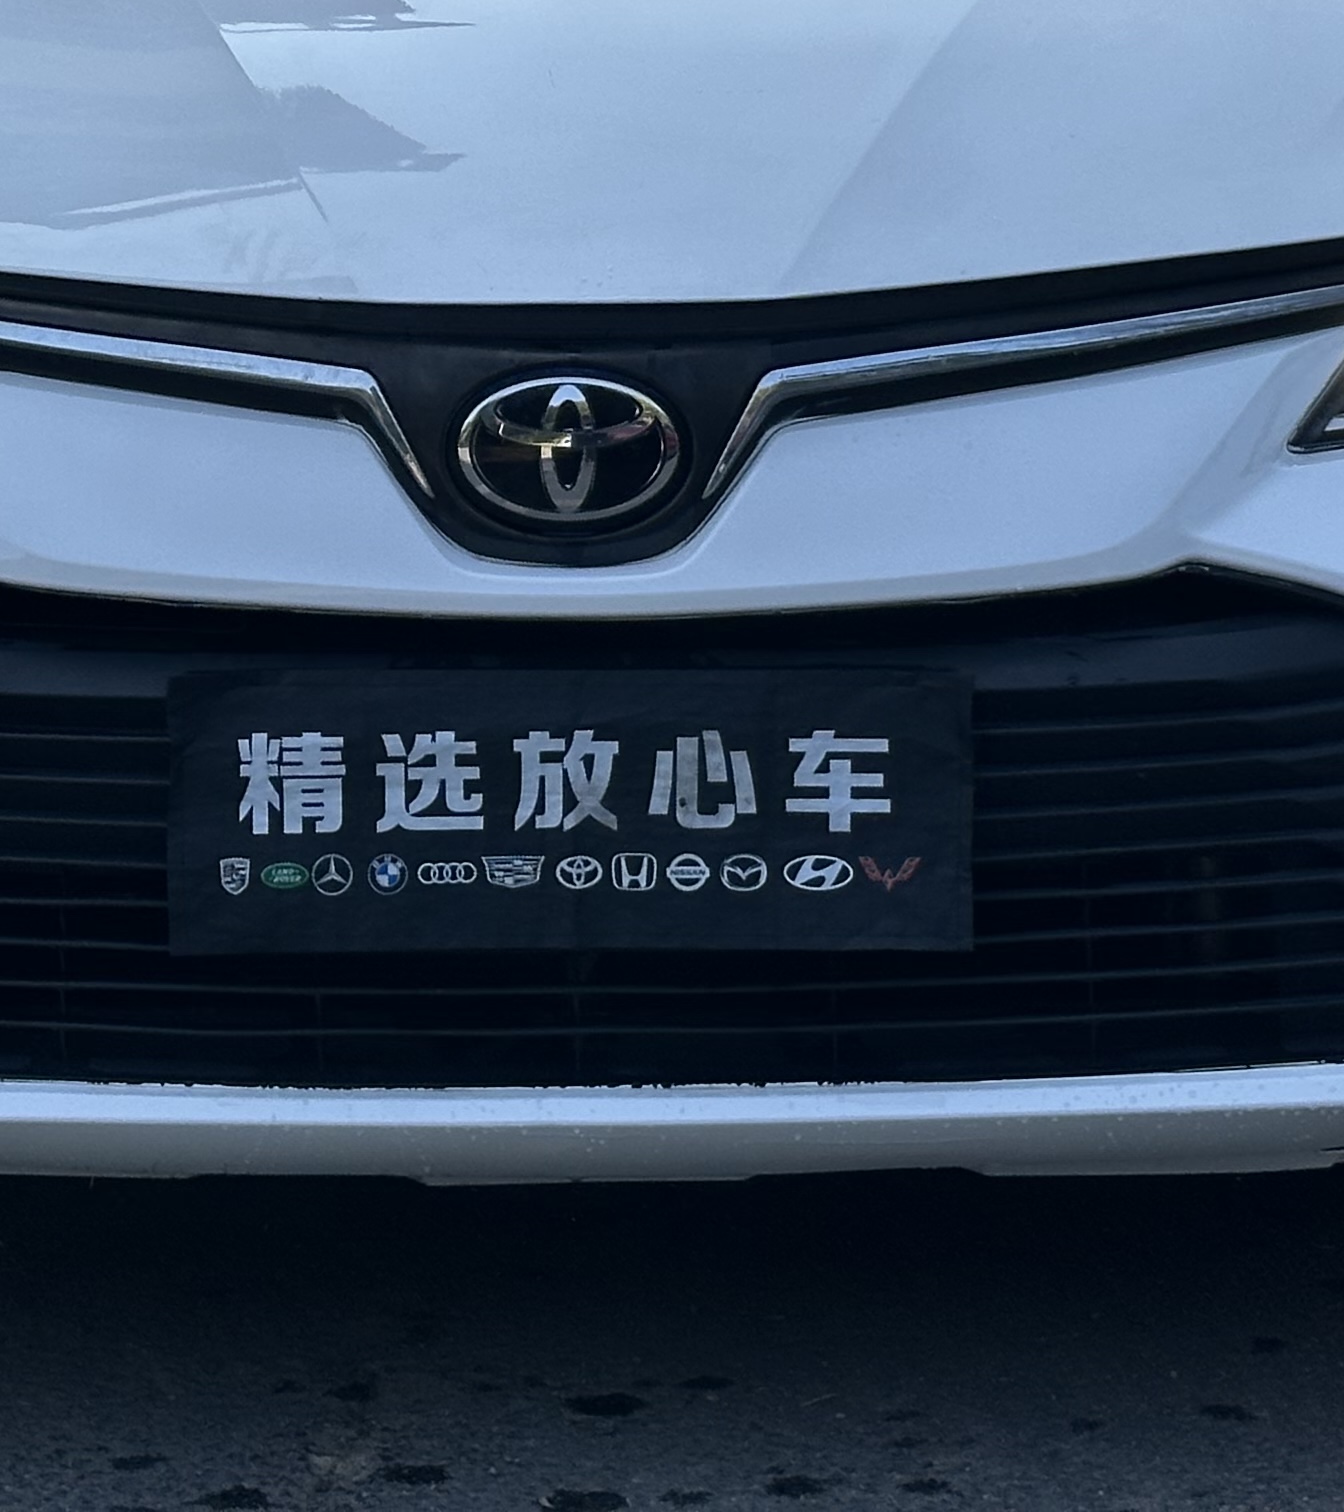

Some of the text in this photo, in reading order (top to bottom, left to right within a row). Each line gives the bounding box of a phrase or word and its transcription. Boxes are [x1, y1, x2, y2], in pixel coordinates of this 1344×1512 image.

[238, 730, 892, 835] 精选放心车
